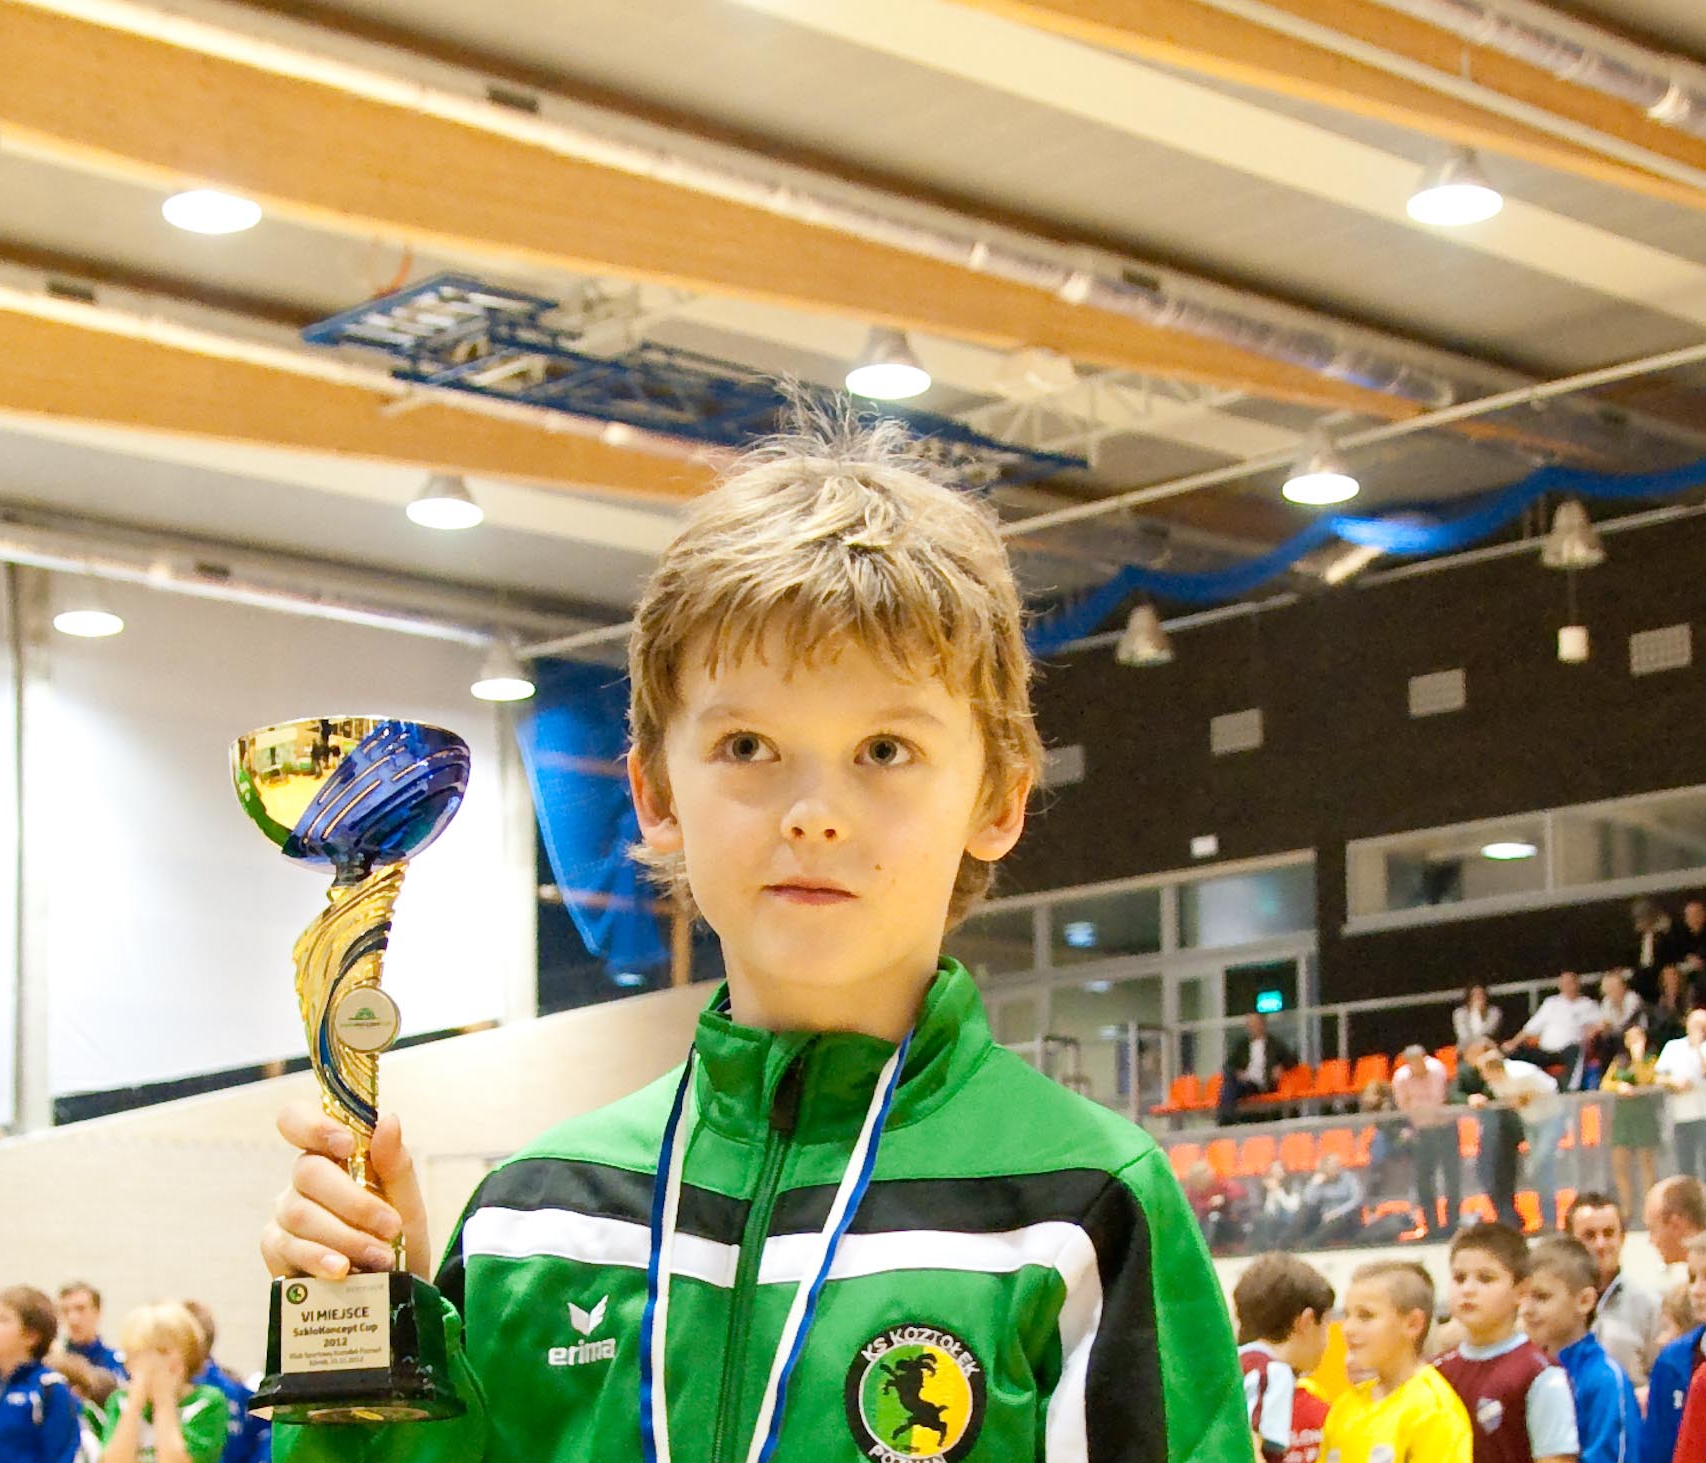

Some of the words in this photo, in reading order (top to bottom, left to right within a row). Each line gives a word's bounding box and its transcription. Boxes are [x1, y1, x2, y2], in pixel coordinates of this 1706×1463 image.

[301, 1309, 315, 1323] VI
[316, 1306, 370, 1323] MIEJSCE
[359, 1322, 378, 1334] Cup
[323, 1337, 348, 1348] 2012
[860, 1334, 890, 1363] KS
[548, 1337, 616, 1367] erima
